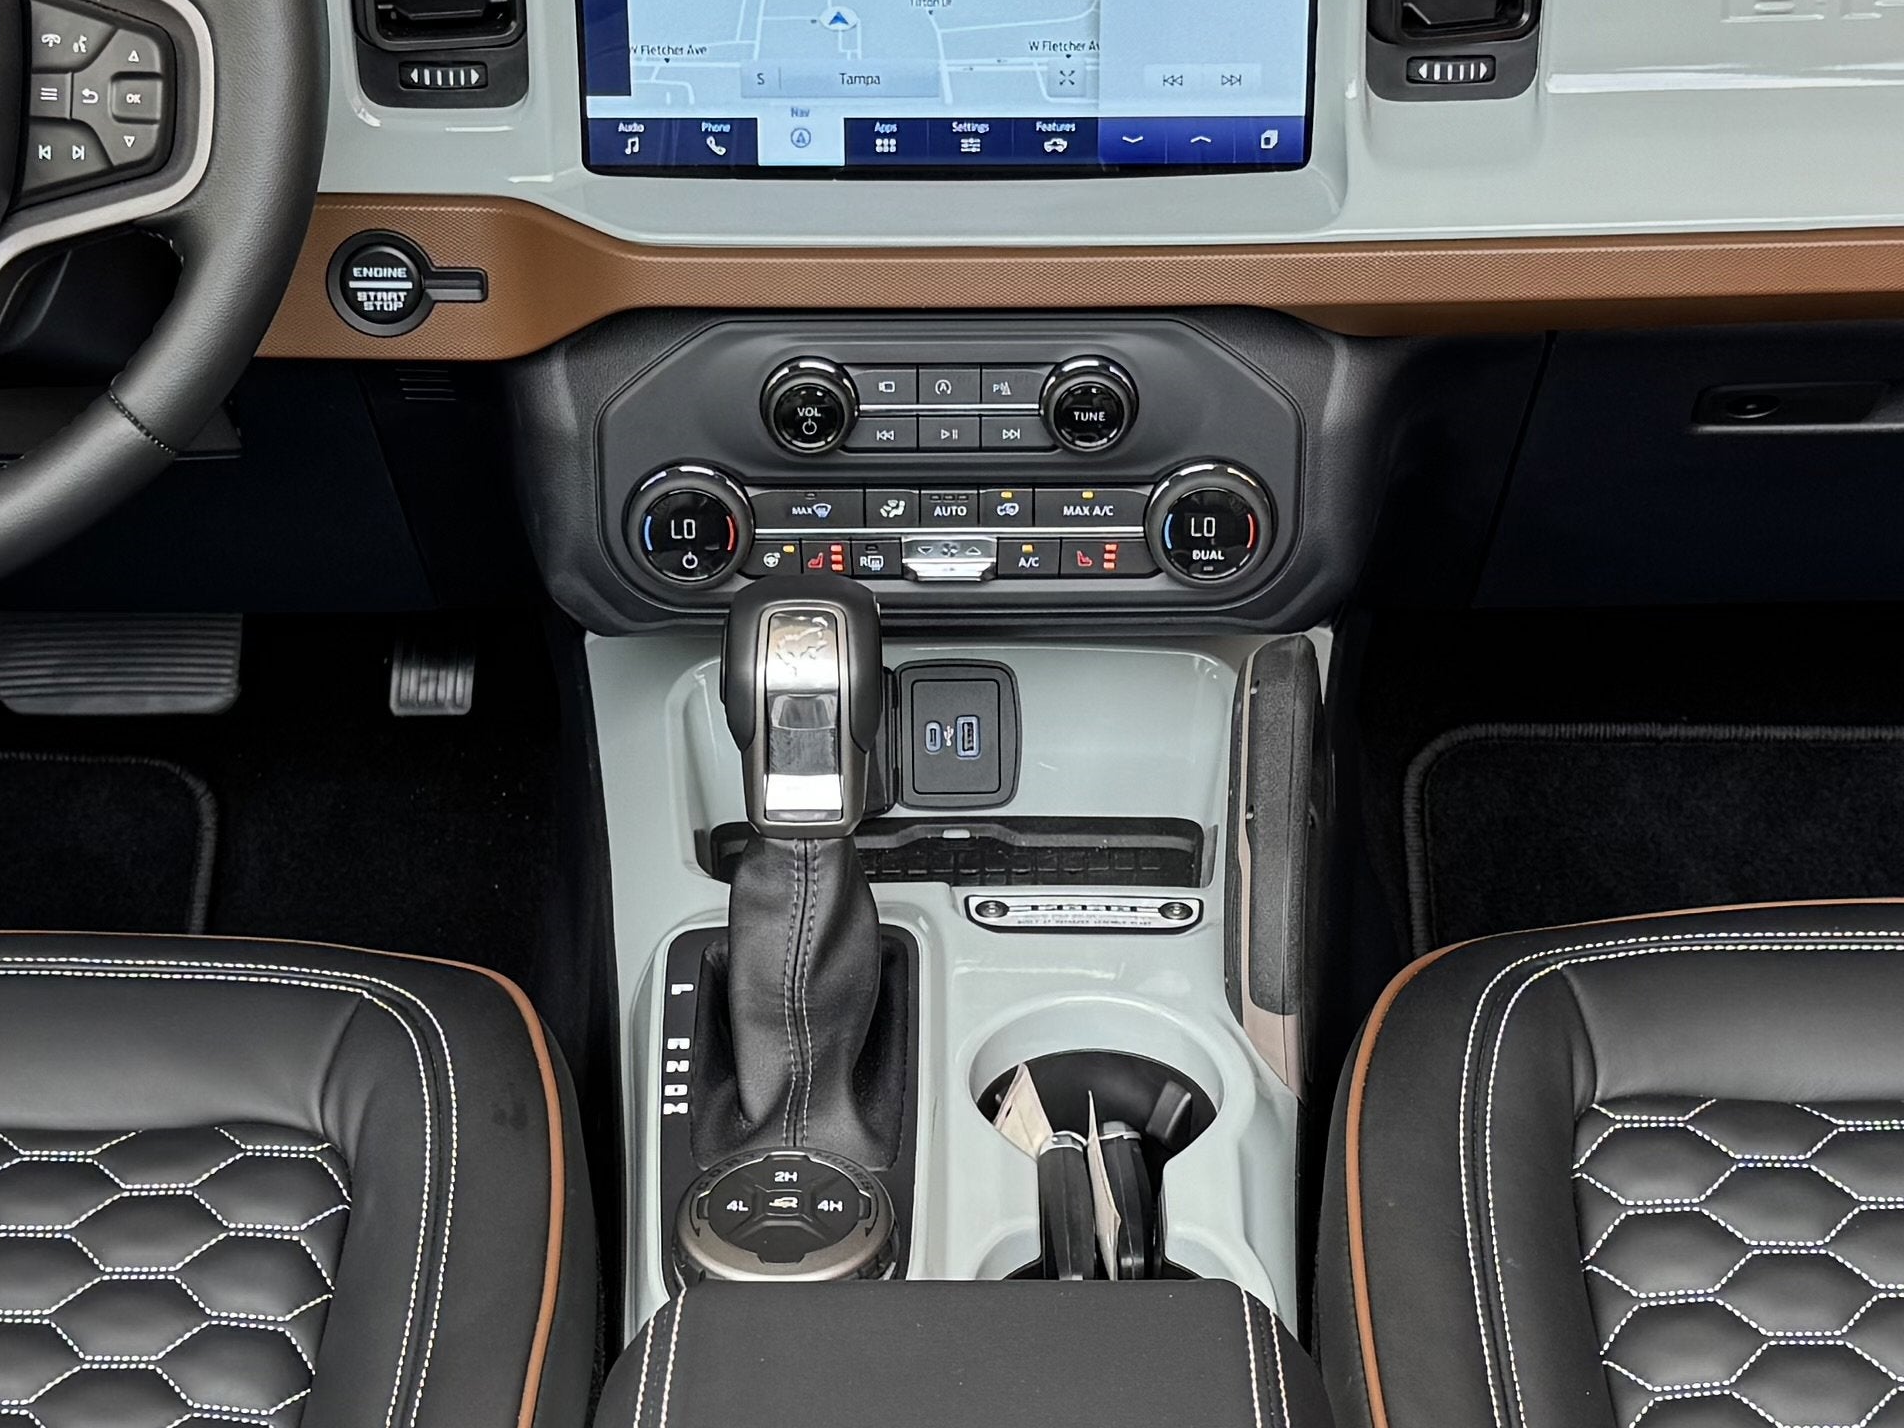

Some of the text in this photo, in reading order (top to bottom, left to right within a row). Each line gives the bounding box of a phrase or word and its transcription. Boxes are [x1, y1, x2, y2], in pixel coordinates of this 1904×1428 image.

[640, 44, 685, 56] Fletcher
[686, 44, 708, 56] Ave
[1029, 40, 1041, 52] W
[1042, 40, 1086, 52] Fletcher
[756, 72, 881, 86] S Tampa
[126, 93, 142, 104] OK
[790, 107, 811, 118] Nav
[618, 122, 645, 133] Audio
[701, 122, 731, 133] Phone
[874, 122, 898, 135] Apps
[952, 121, 990, 135] Settings
[1035, 121, 1076, 133] Features
[352, 267, 408, 278] ENGINE
[357, 291, 407, 302] START
[363, 300, 404, 312] STOP
[797, 406, 822, 418] VOL
[1073, 411, 1106, 423] TUNE
[791, 506, 813, 516] MAX
[933, 505, 967, 517] AUTO
[1062, 505, 1114, 517] MAX A/C
[670, 518, 697, 540] LO
[1190, 516, 1216, 538] LO
[1192, 549, 1225, 562] DUAL
[1018, 556, 1040, 569] A/C
[774, 1171, 798, 1183] 2H
[726, 1200, 749, 1212] 4L
[817, 1200, 843, 1212] 4H
